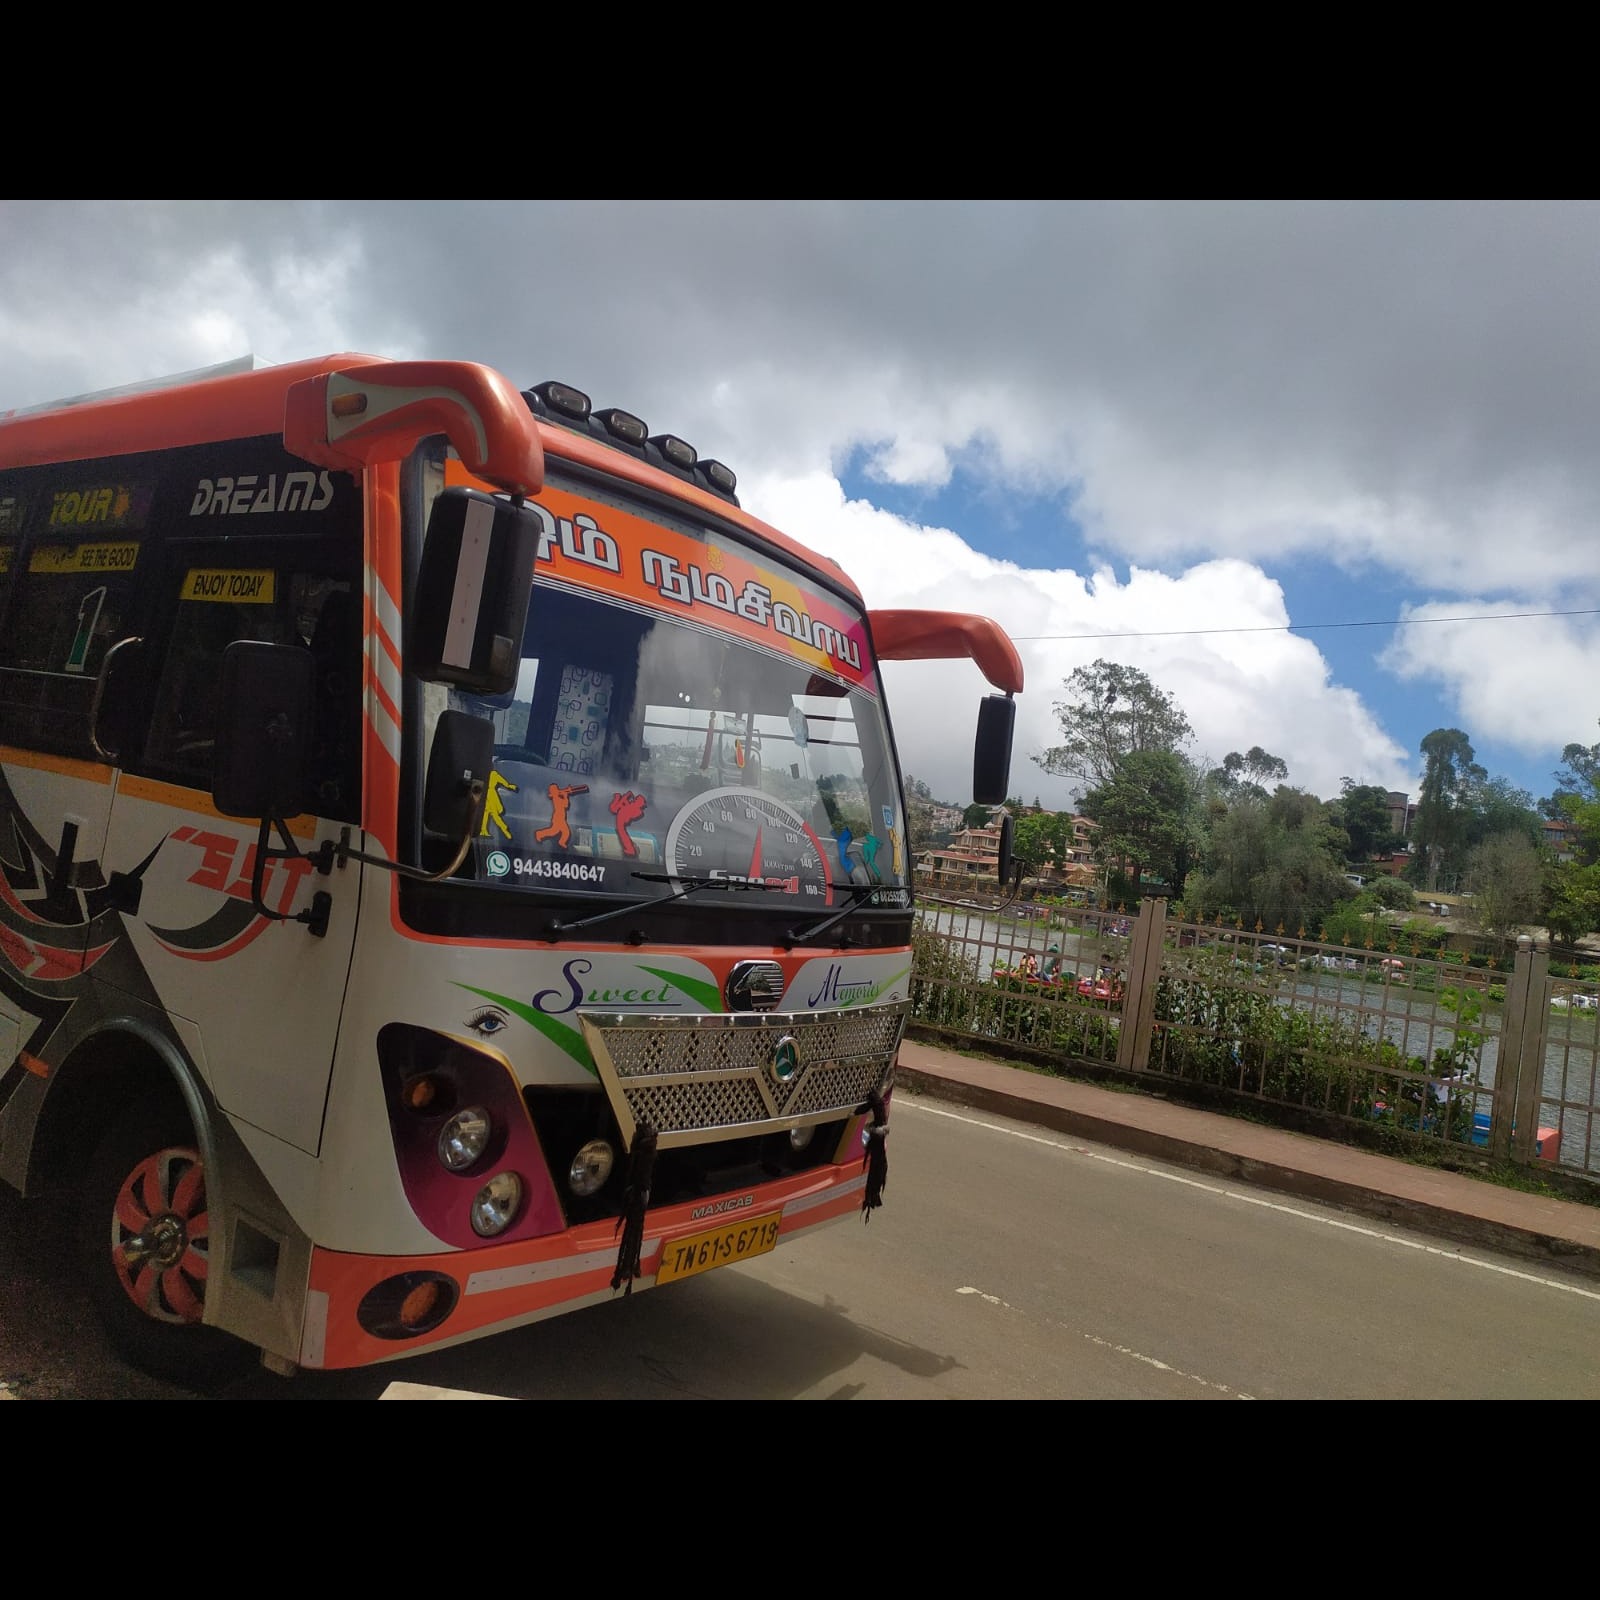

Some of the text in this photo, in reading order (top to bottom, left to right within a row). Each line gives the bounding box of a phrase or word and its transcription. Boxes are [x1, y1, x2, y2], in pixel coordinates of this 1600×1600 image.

[189, 470, 335, 516] DREAMS
[109, 547, 135, 567] GOOD
[193, 574, 265, 598] ENJOY TODAY
[640, 548, 863, 672] நமசிவாய
[721, 811, 733, 822] 60
[745, 808, 757, 820] 80
[703, 821, 715, 833] 40
[785, 833, 798, 844] 120
[689, 845, 702, 857] 20
[513, 857, 606, 882] 9443840647
[800, 858, 813, 869] 140
[805, 884, 818, 895] 160
[532, 958, 880, 1014] Sweet Memories
[691, 1194, 754, 1219] MAXICAB
